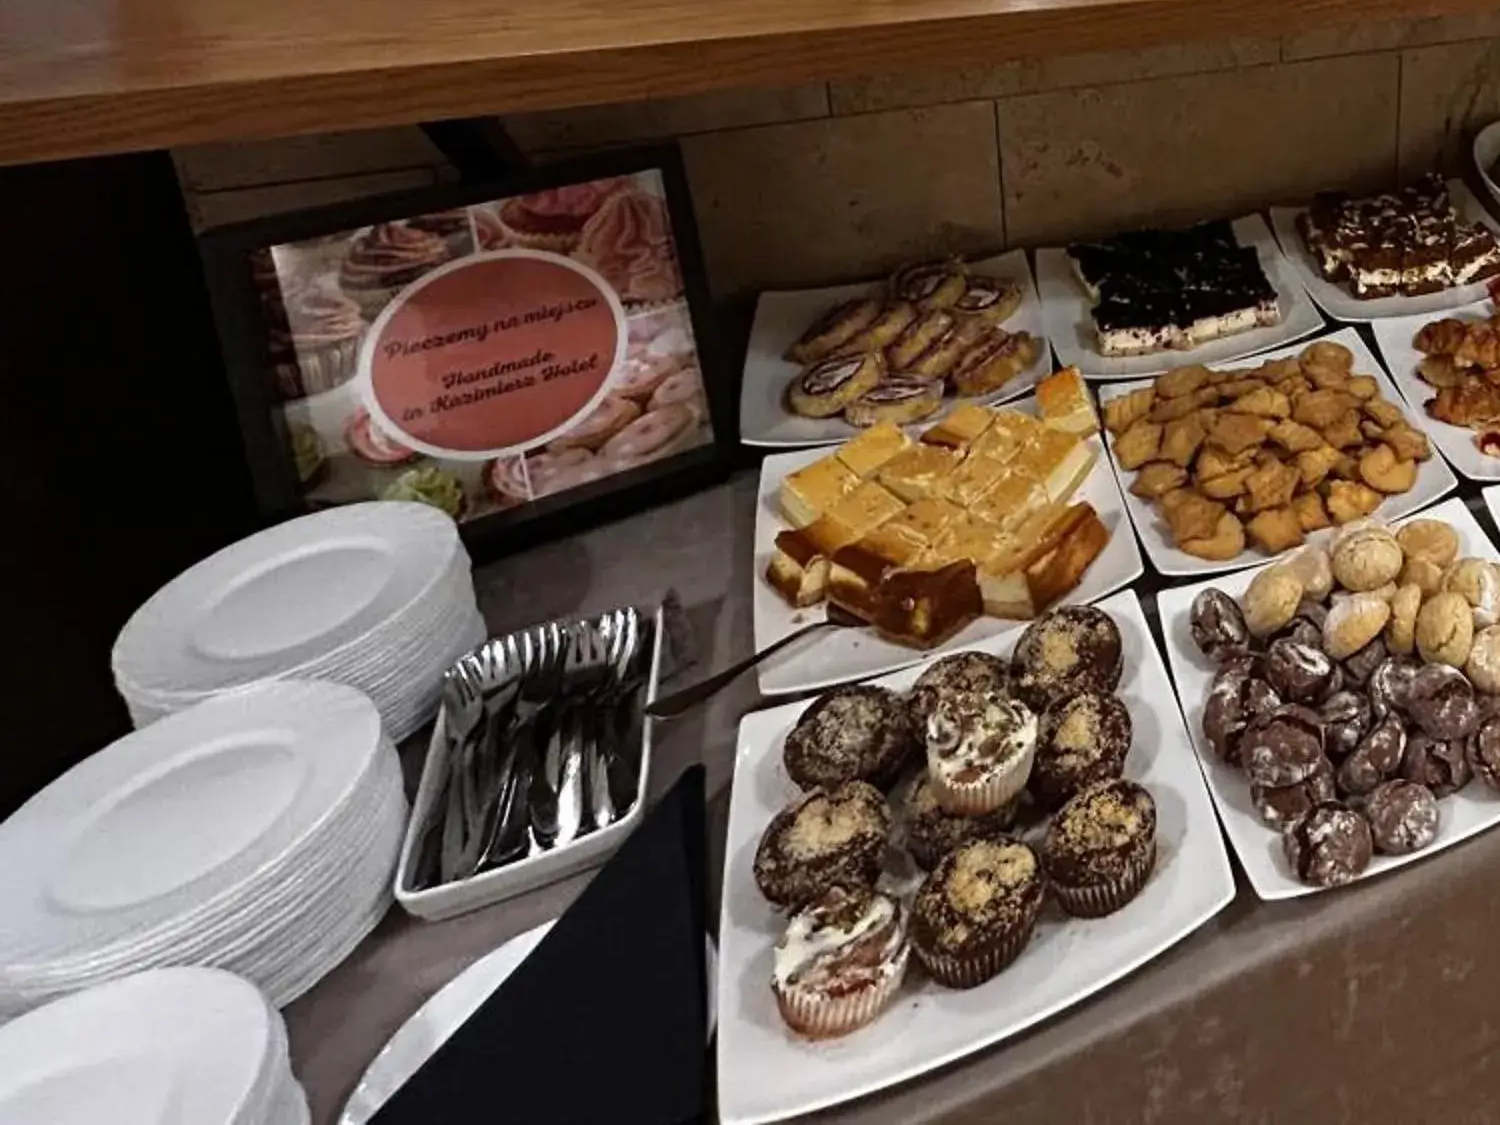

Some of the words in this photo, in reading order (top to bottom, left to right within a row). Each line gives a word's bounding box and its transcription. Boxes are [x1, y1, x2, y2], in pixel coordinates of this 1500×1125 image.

[384, 321, 489, 359] Pieczemy
[493, 316, 520, 332] na
[524, 298, 598, 323] miejscu
[402, 407, 424, 422] in
[430, 375, 536, 414] Kazimierz
[541, 351, 599, 381] Hotel
[442, 349, 555, 389] Handmade
